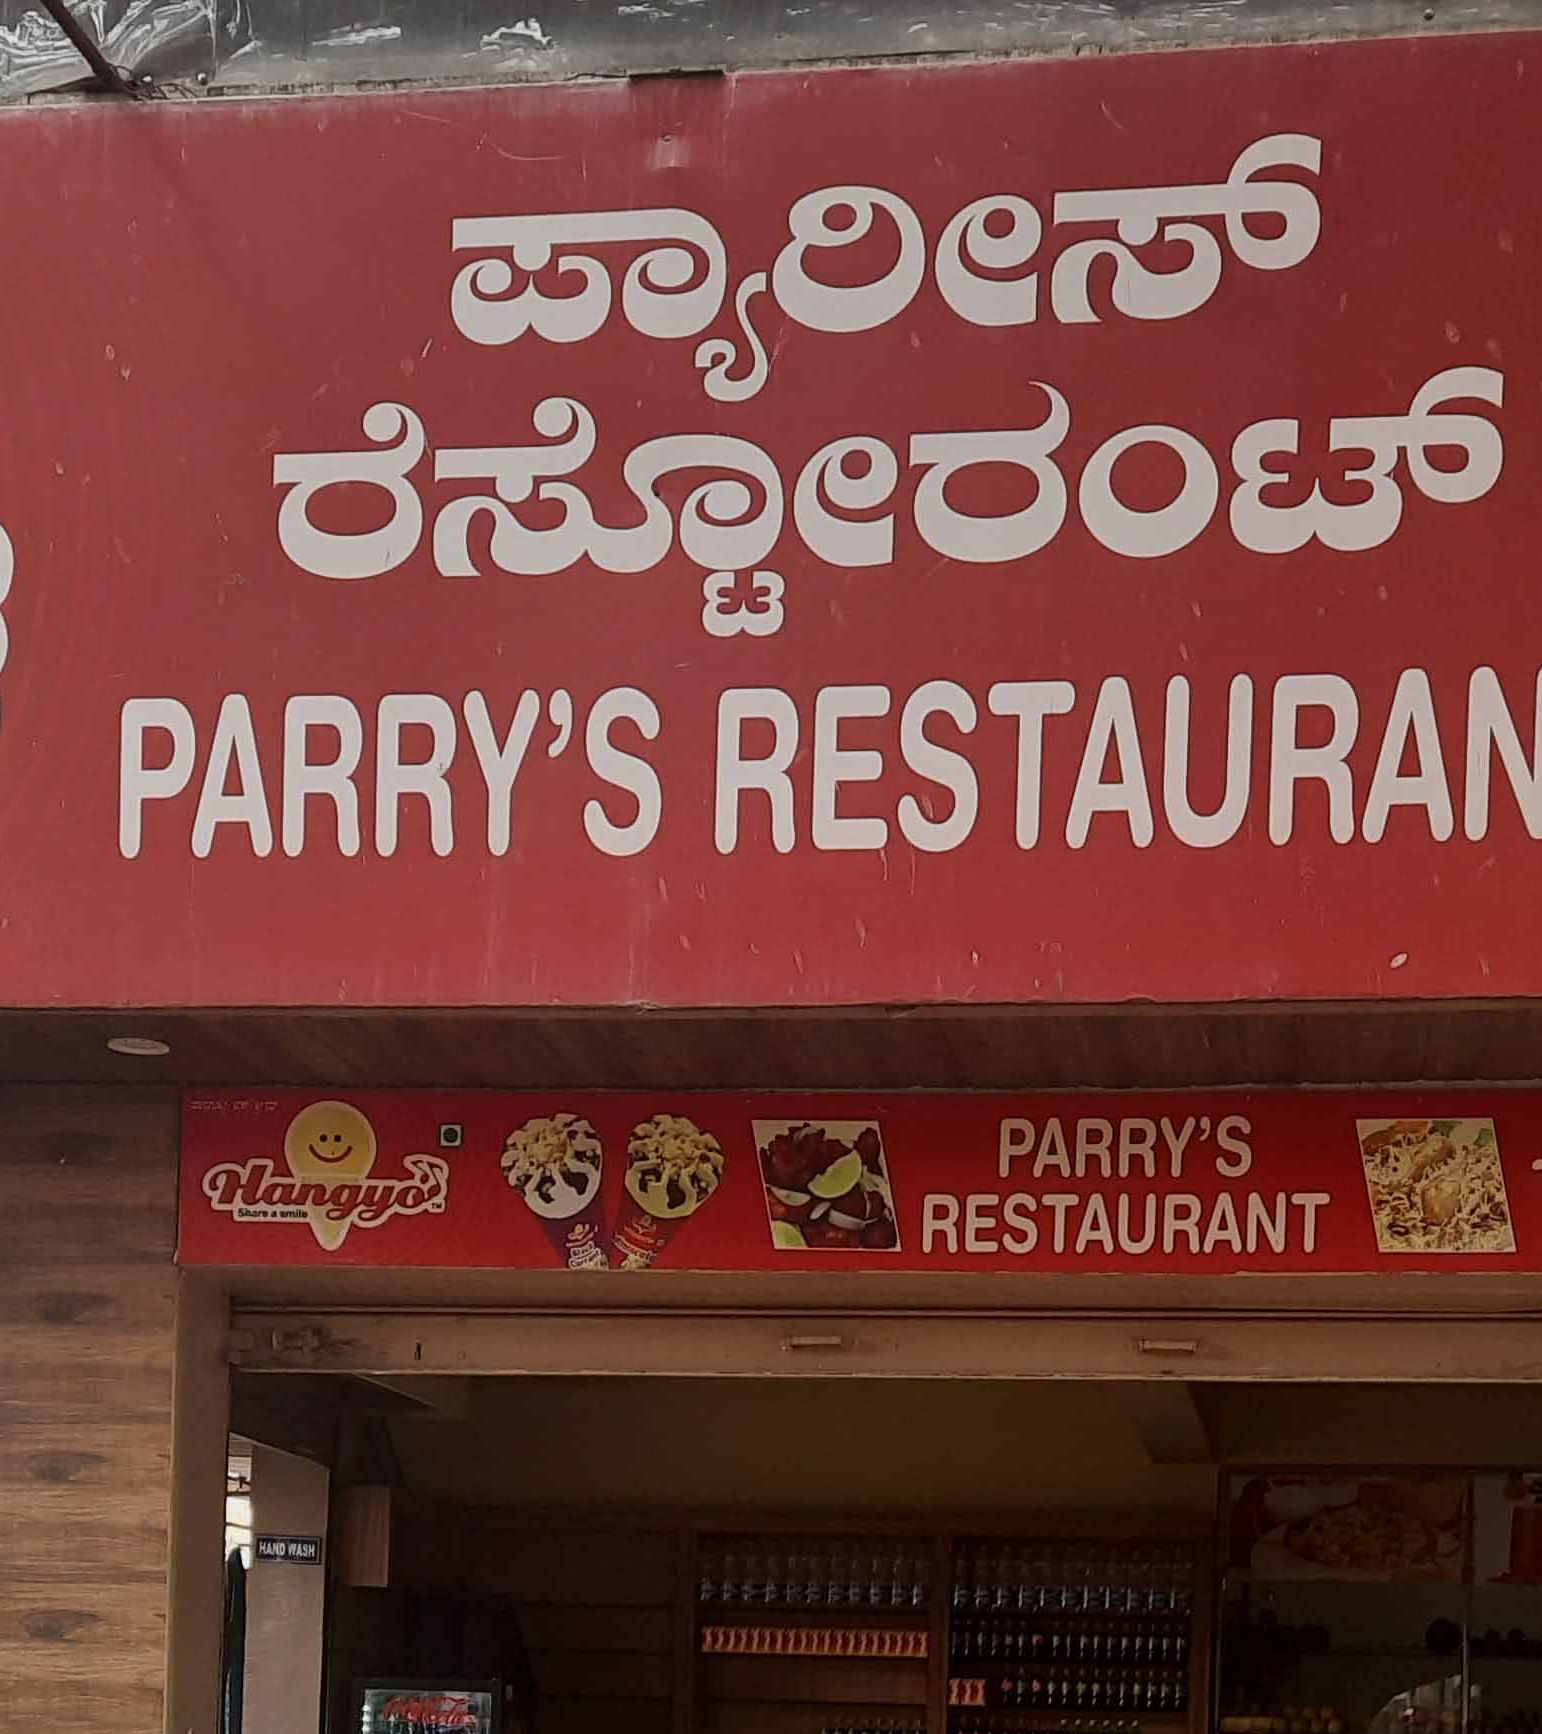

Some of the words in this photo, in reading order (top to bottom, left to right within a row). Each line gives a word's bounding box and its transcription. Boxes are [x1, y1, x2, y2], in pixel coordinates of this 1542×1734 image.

[451, 133, 1322, 403] ಪ್ಯಾರೀಸ್
[272, 364, 1506, 638] ರೆಸ್ಟೋರಂಟ್
[118, 684, 665, 861] PARRY'S
[997, 1114, 1253, 1179] PARRY'S
[208, 1159, 446, 1221] Hangyo
[237, 1207, 269, 1219] Share
[270, 1210, 278, 1219] a
[279, 1208, 309, 1219] smile
[921, 1190, 1333, 1257] RESTAURANT
[258, 1541, 286, 1556] HAND
[288, 1542, 316, 1558] WASH
